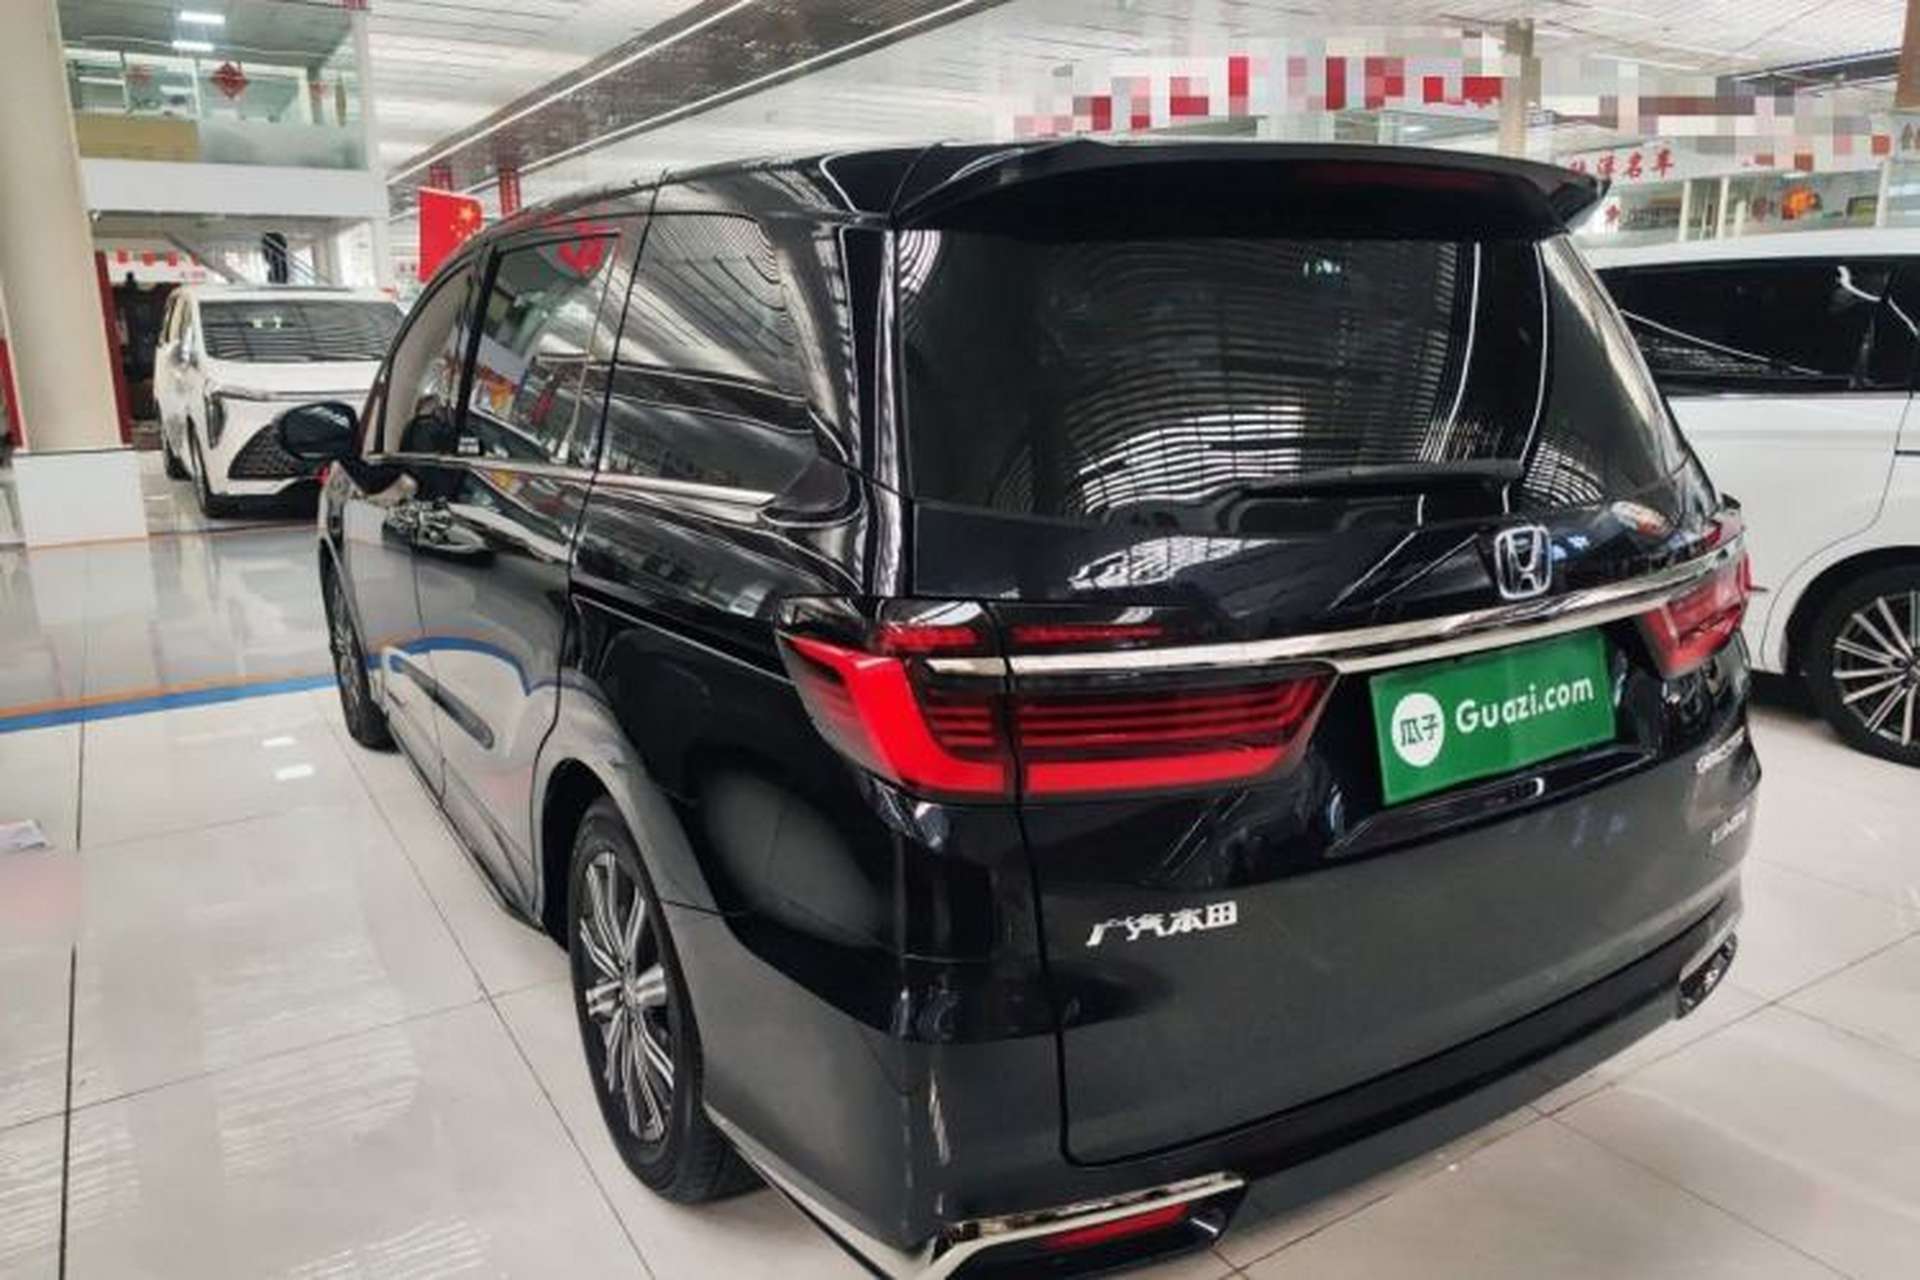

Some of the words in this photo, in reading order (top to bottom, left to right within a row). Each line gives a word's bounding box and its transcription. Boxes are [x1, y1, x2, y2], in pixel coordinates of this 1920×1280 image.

[1456, 677, 1594, 733] Guazi.com
[1399, 713, 1439, 747] 瓜子
[1085, 900, 1238, 947] 广汽本田
